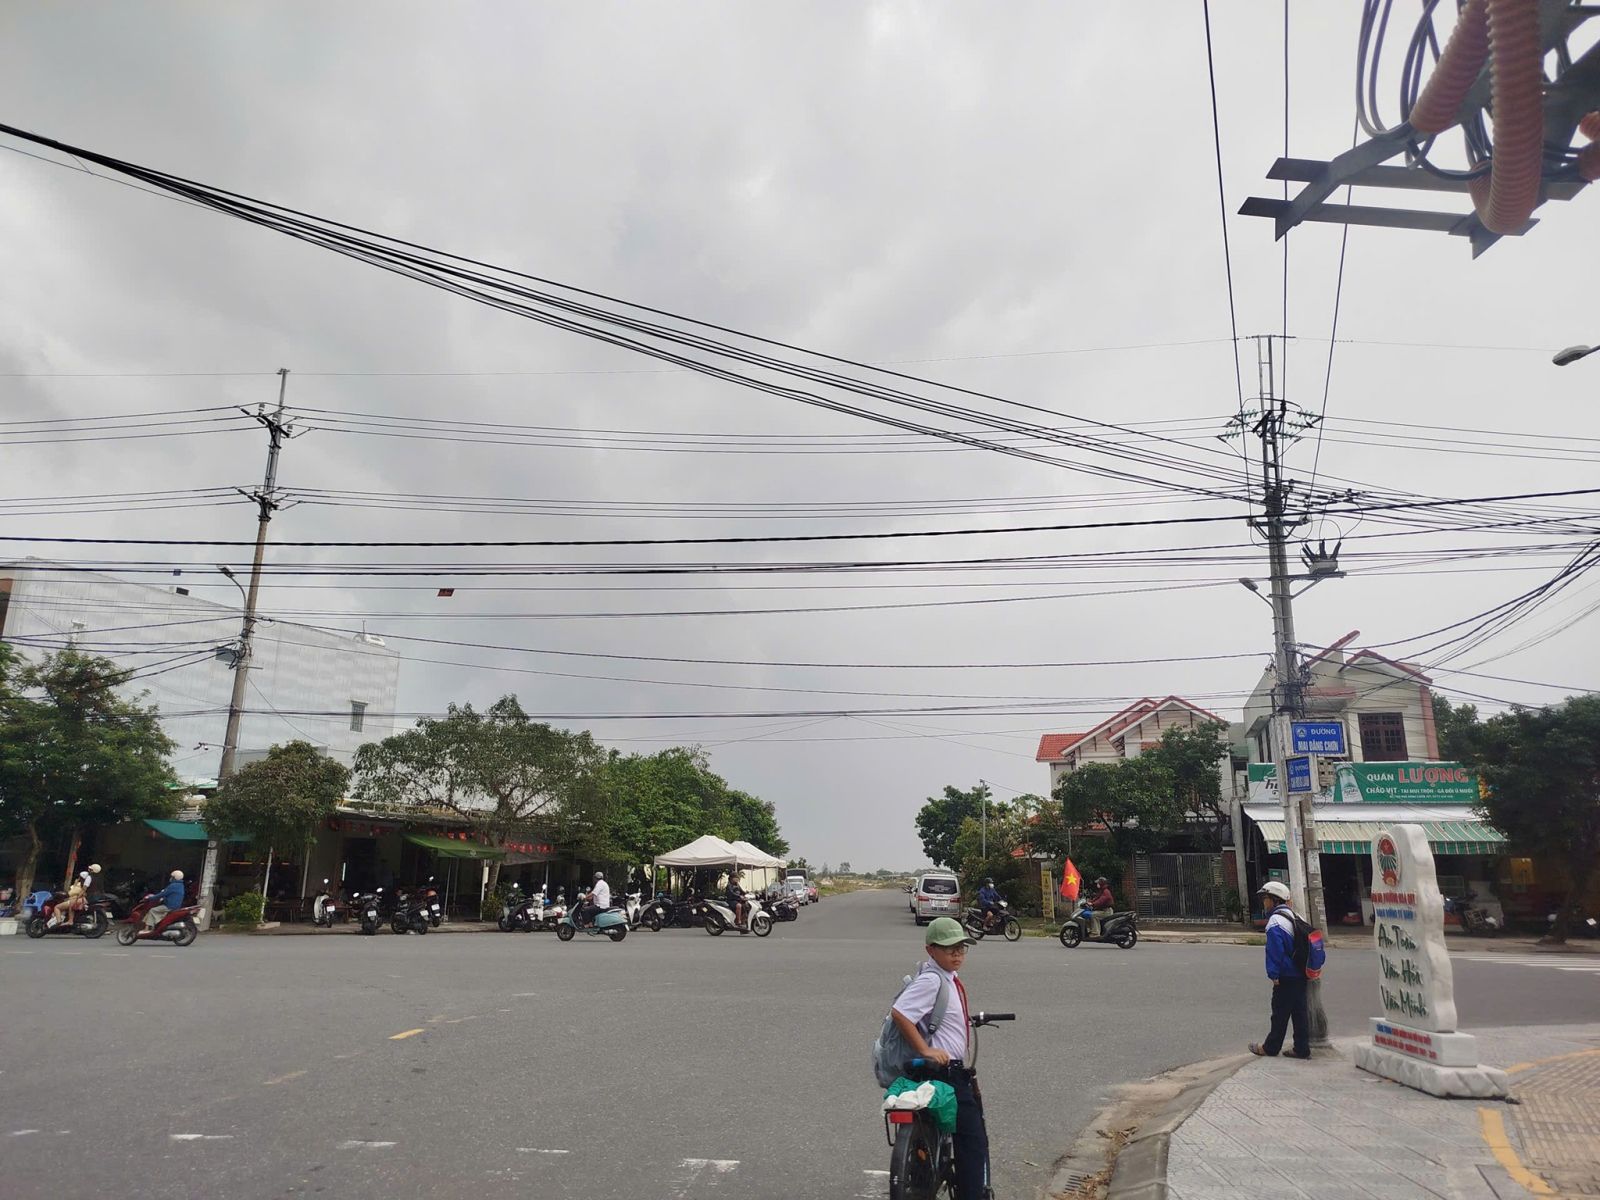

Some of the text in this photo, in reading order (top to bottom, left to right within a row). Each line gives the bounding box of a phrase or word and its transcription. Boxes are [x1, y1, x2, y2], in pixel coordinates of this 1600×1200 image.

[1310, 726, 1337, 735] ĐƯỜNG
[1398, 766, 1469, 787] LƯỢNG
[1400, 989, 1426, 1018] Minh
